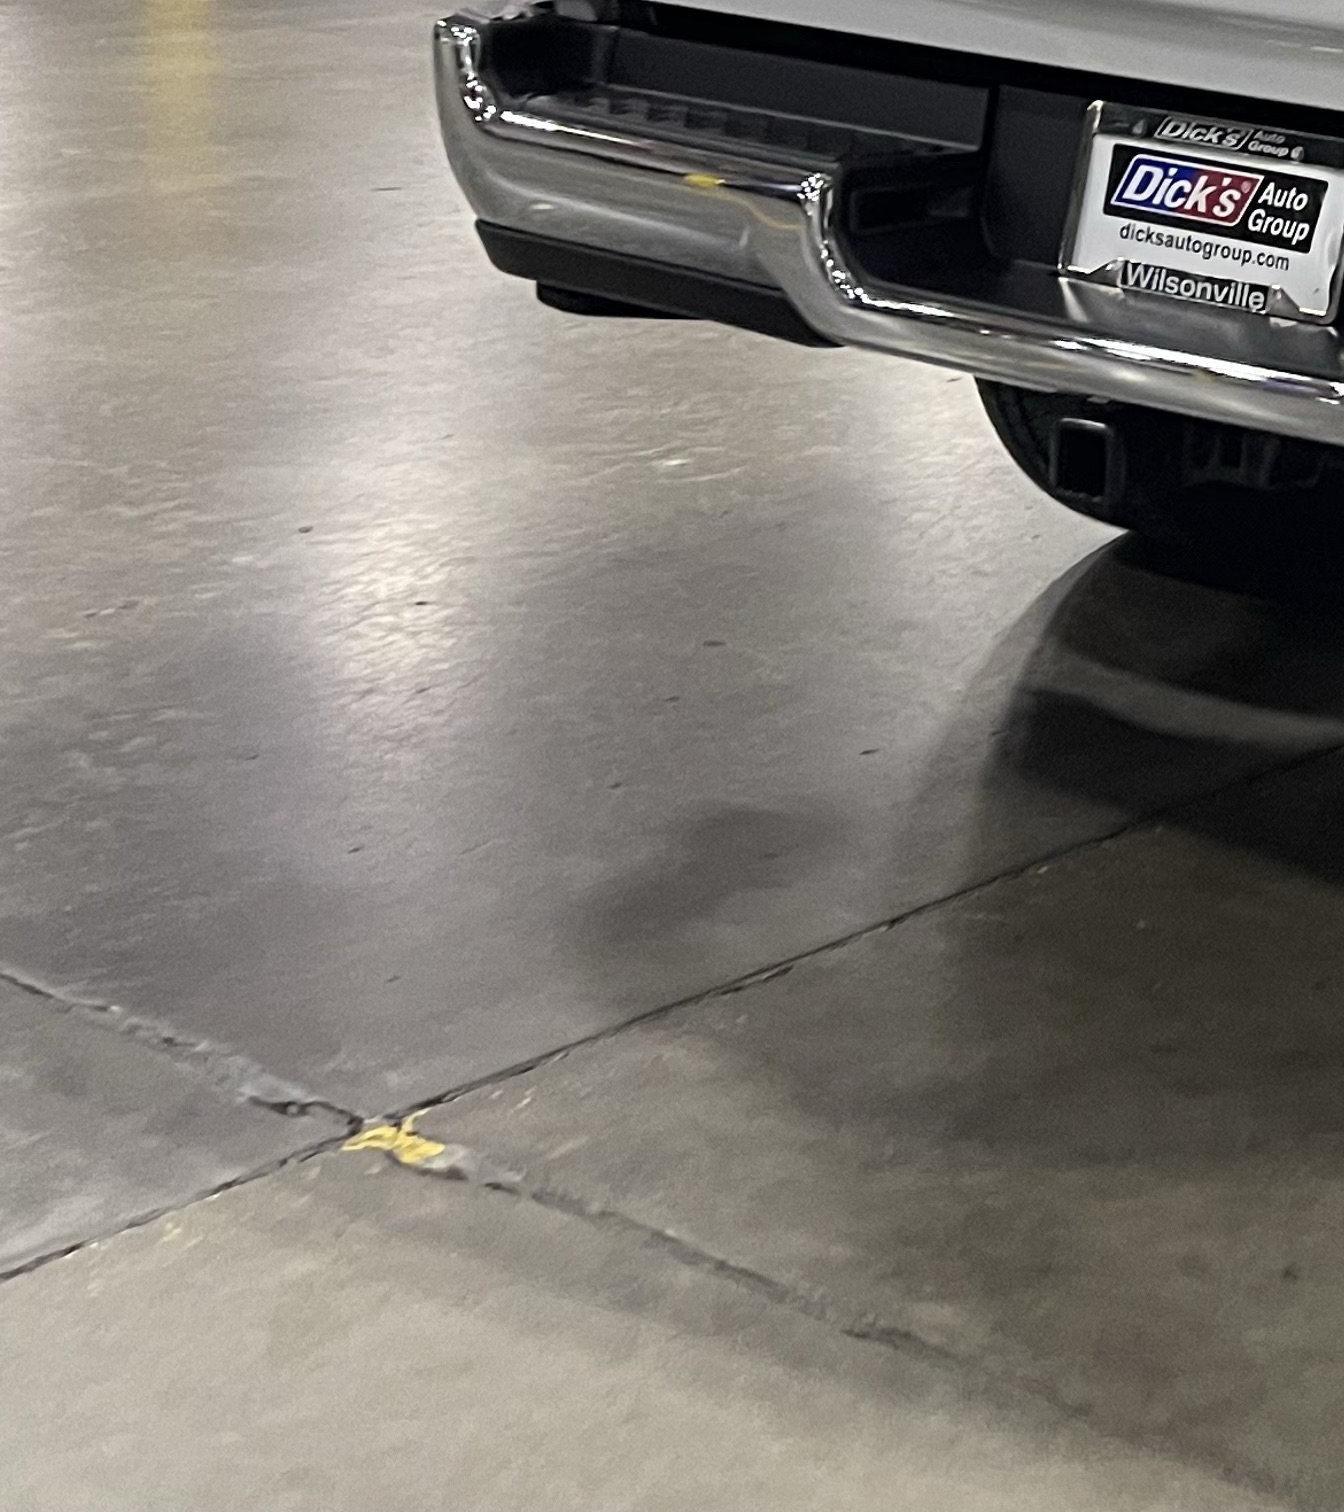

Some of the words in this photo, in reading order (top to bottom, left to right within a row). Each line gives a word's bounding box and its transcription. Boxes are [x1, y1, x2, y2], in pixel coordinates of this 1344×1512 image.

[1160, 118, 1243, 148] Dick's
[1248, 141, 1289, 158] Group
[1254, 130, 1286, 144] Auto
[1121, 164, 1242, 218] Dick's
[1258, 182, 1309, 211] Auto
[1248, 208, 1310, 245] Group
[1119, 223, 1290, 271] dicksautogroup.com
[1126, 262, 1266, 312] Wilsonville
